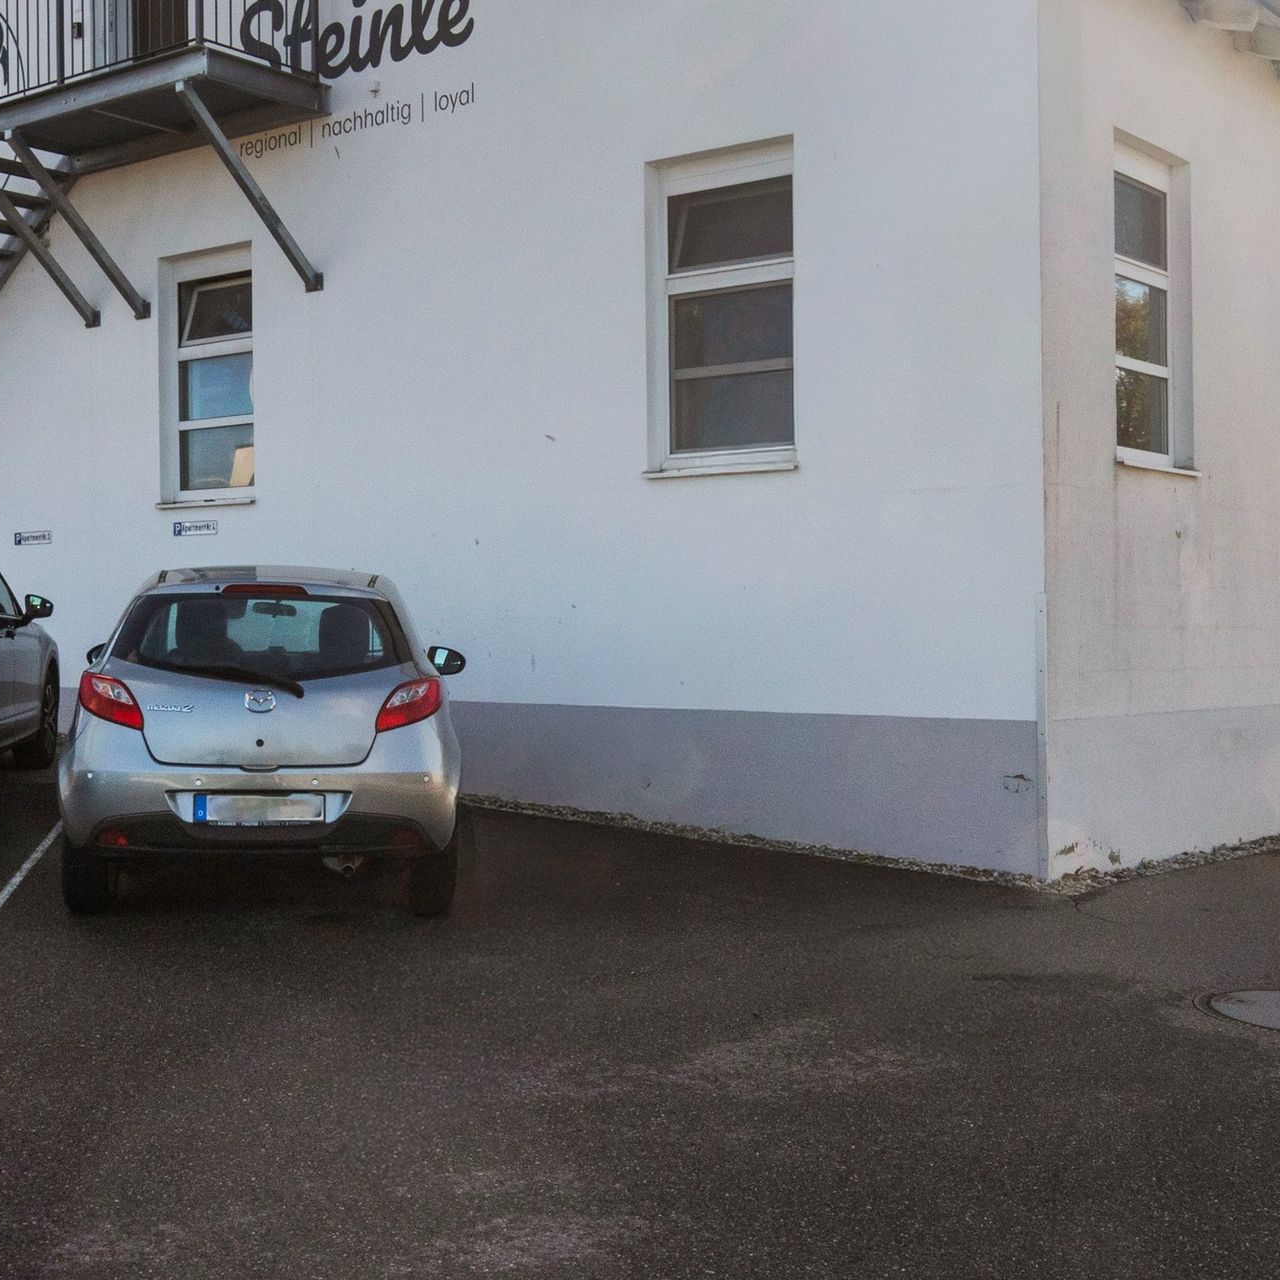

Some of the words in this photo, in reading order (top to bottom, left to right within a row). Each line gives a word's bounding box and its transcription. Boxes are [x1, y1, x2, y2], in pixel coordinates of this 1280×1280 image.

[239, 125, 302, 158] regional
[321, 99, 412, 138] nachhaltig
[433, 82, 475, 113] loyal
